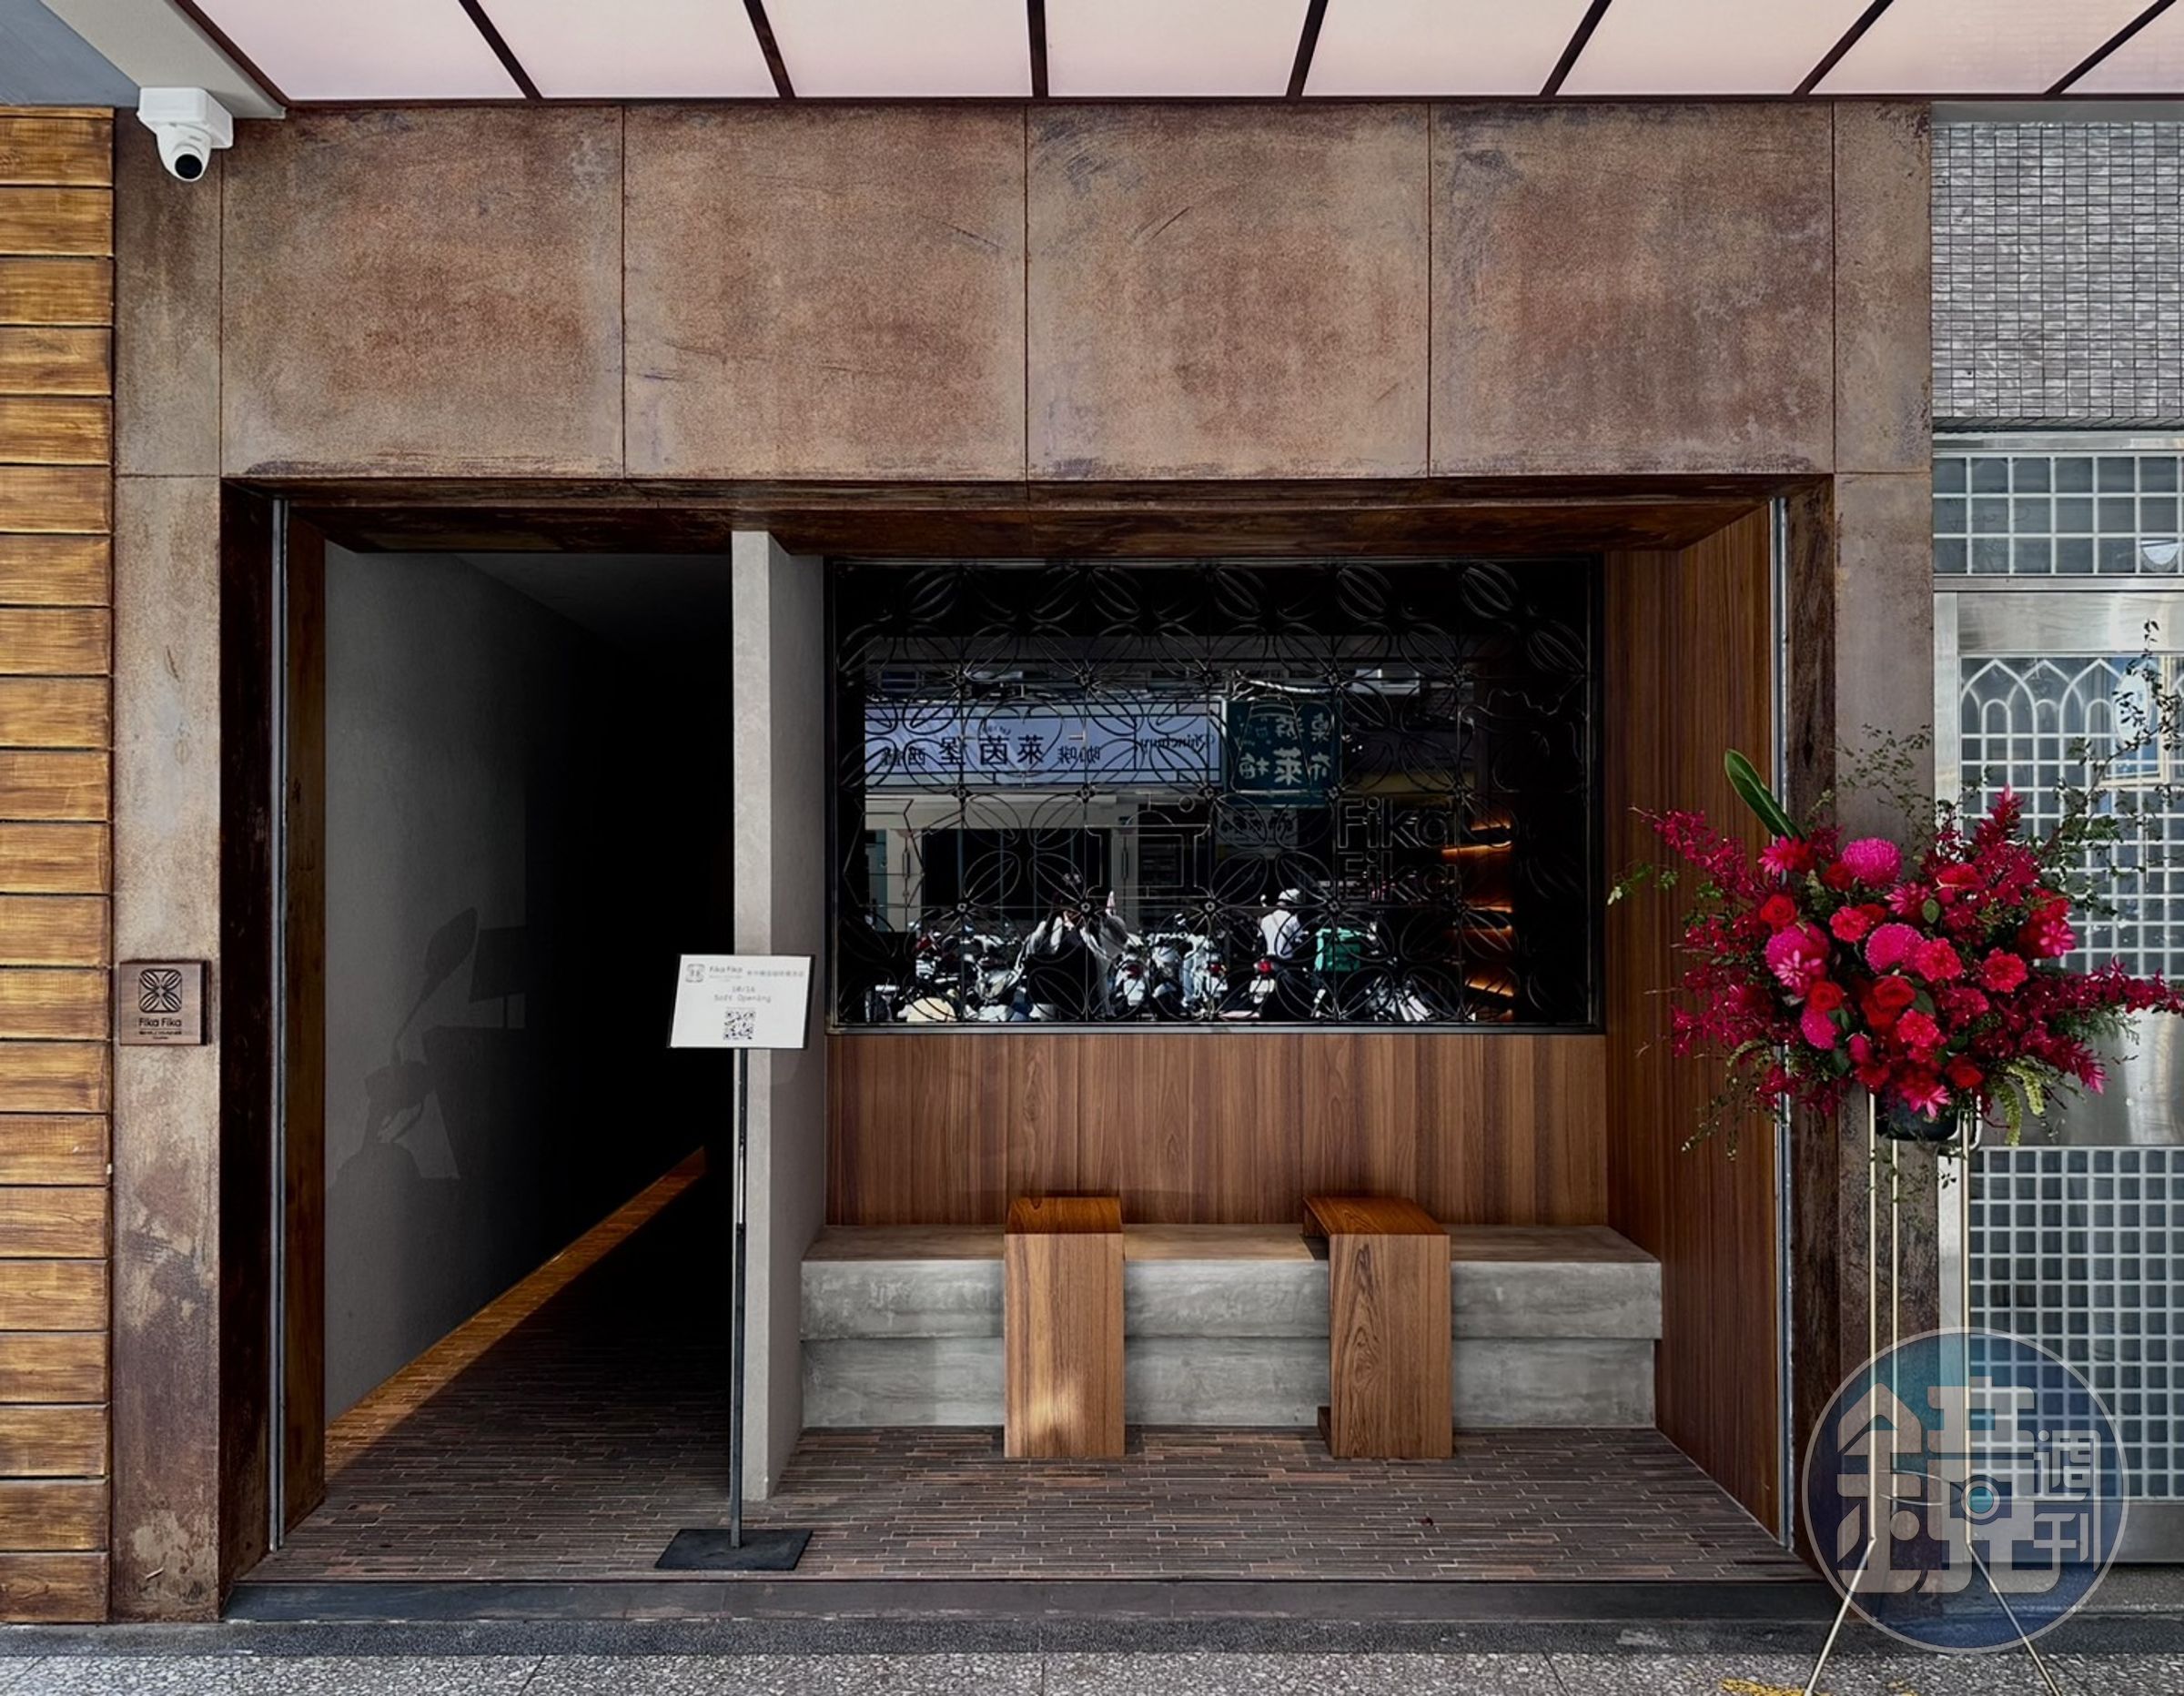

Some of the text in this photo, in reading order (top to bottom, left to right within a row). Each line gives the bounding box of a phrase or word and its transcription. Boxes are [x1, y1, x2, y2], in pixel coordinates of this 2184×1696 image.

[1336, 797, 1456, 848] Fika
[1336, 851, 1456, 903] Fika
[737, 994, 772, 1003] Opening
[139, 1017, 182, 1026] Fika Fika
